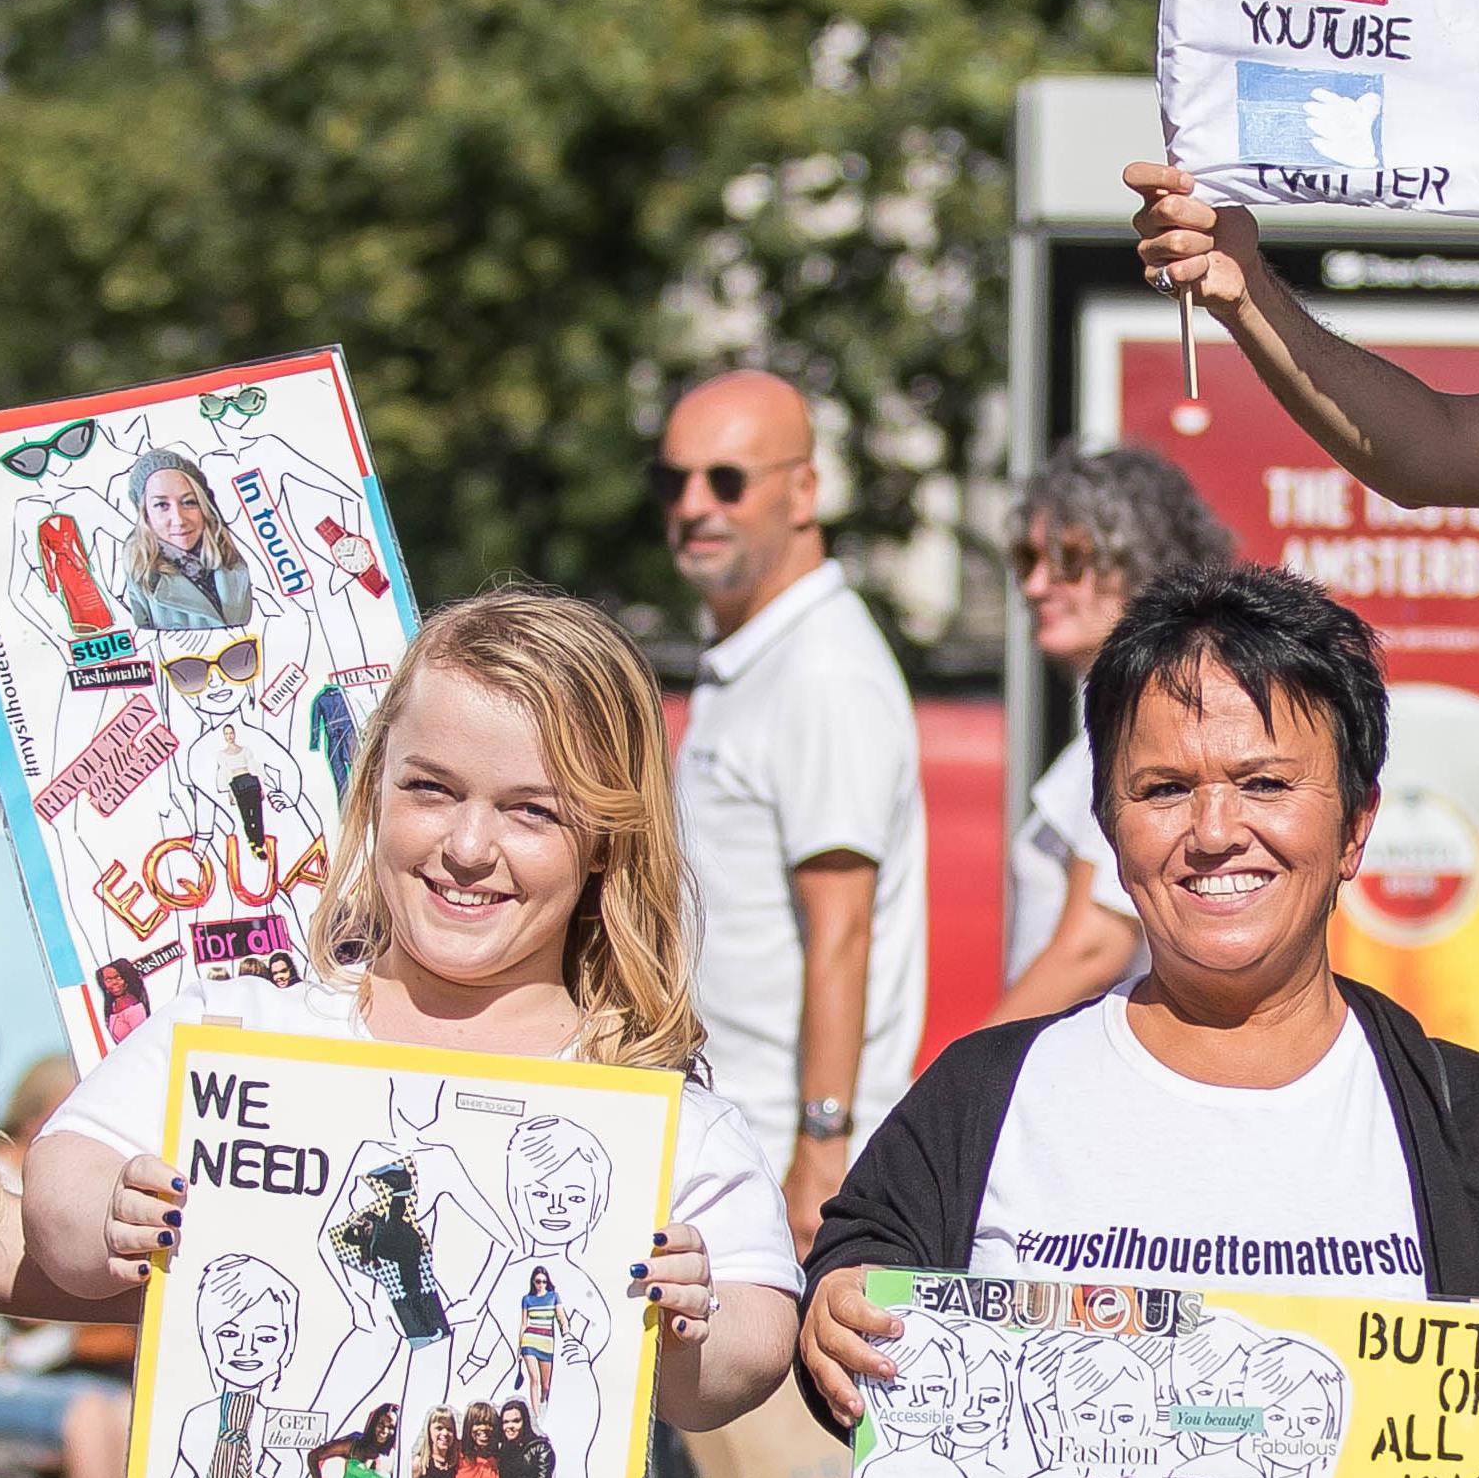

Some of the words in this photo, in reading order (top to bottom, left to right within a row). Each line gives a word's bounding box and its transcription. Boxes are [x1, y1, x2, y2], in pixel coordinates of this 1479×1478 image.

[1241, 0, 1413, 62] YOUTUBE
[236, 472, 261, 503] In
[252, 508, 307, 594] touch
[72, 635, 132, 662] style
[73, 663, 152, 687] Fashionable
[37, 705, 154, 819] REVOLUTION
[93, 833, 365, 942] EQUA
[194, 926, 237, 960] for
[190, 1071, 271, 1130] WE
[190, 1138, 330, 1197] NEED
[913, 1277, 1204, 1338] FABULOUS
[279, 1414, 317, 1431] GET
[878, 1408, 955, 1427] Accessible
[1177, 1412, 1202, 1427] You
[1205, 1413, 1255, 1430] beauty!
[268, 1432, 292, 1447] the
[1055, 1435, 1159, 1466] Fashion
[1252, 1438, 1338, 1457] Fabulous
[1371, 1413, 1464, 1463] ALL
